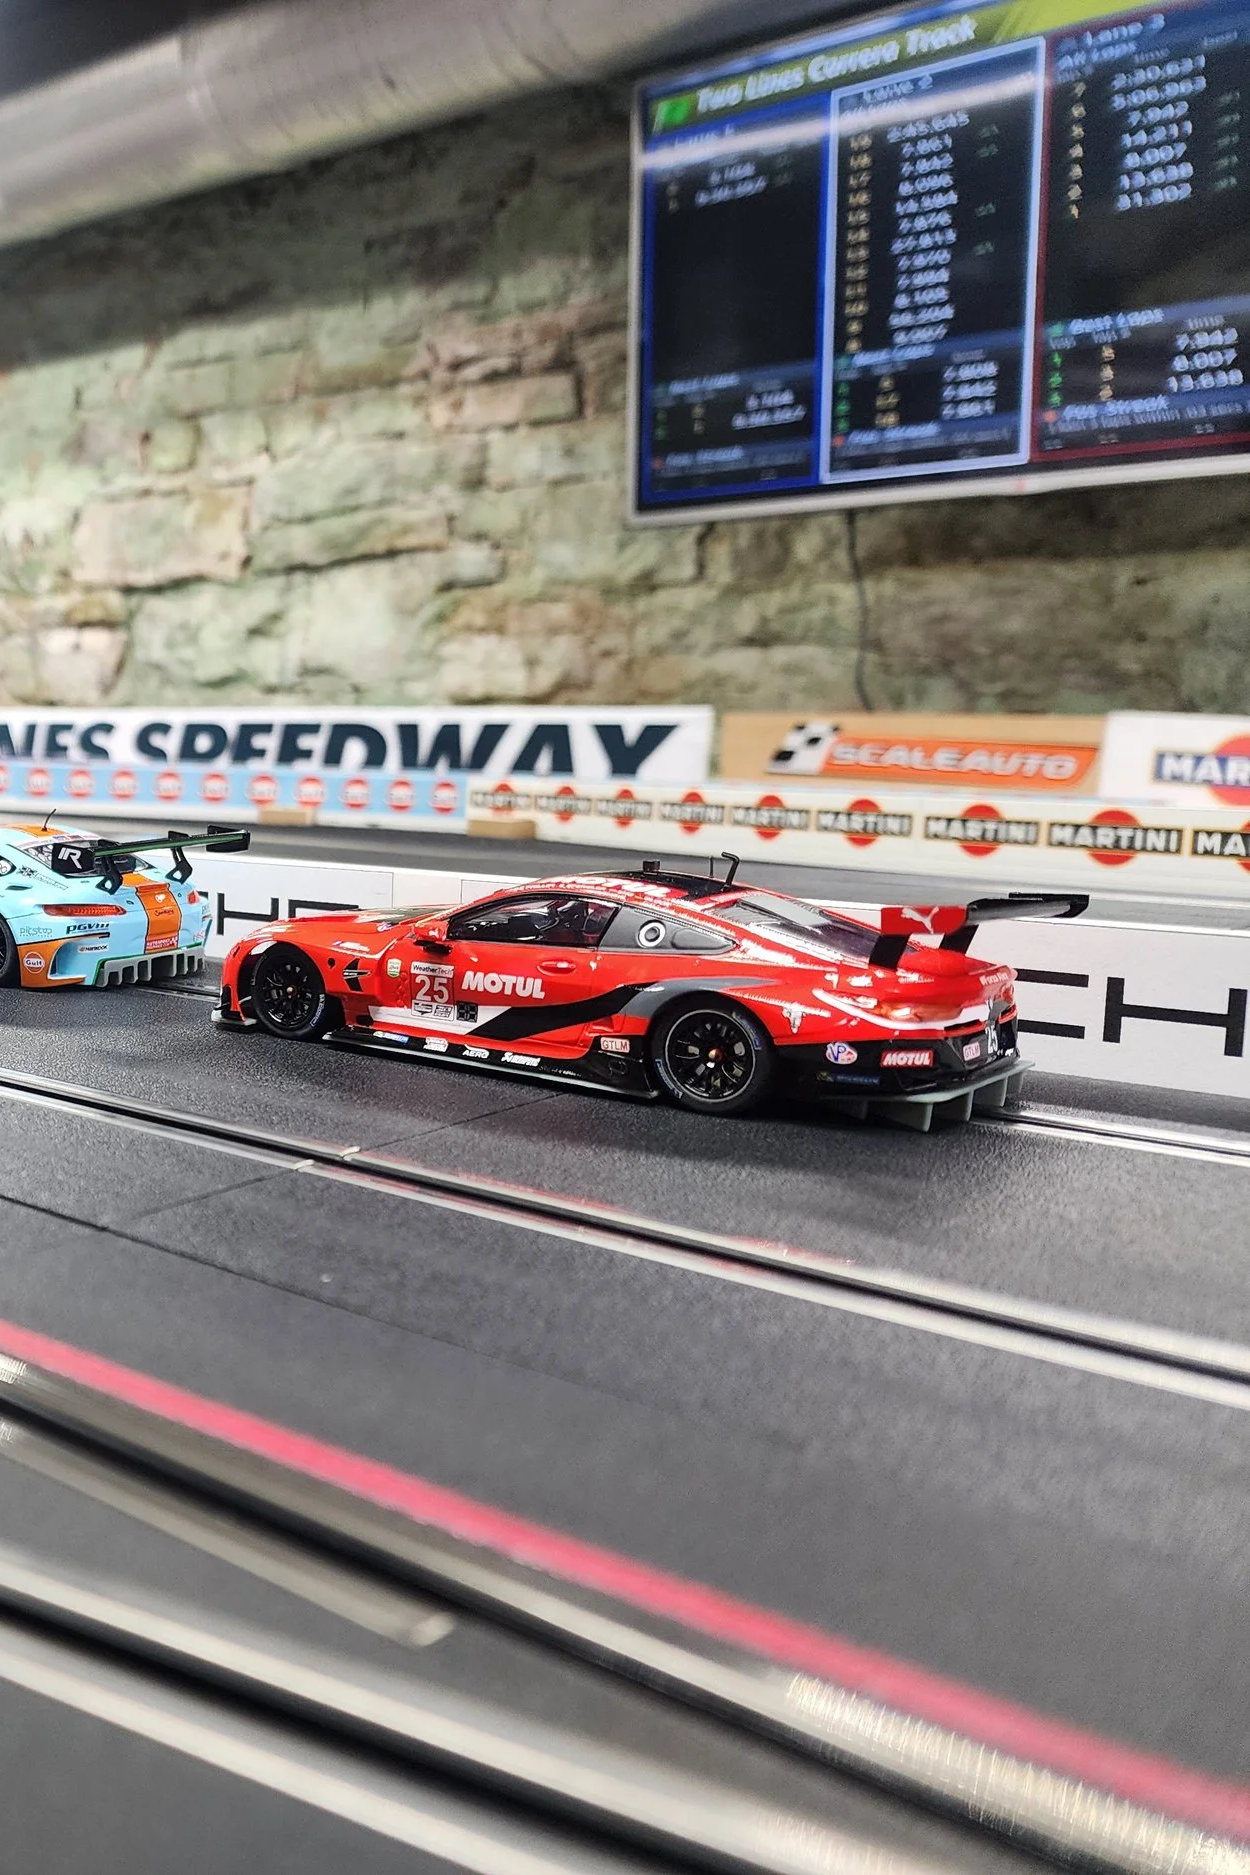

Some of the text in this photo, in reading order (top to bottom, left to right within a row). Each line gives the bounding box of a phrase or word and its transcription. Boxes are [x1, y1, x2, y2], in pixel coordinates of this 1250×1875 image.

[135, 722, 680, 777] SPEEDWAY
[829, 740, 1078, 781] SCALEAUTO
[732, 806, 810, 830] MARTINI
[818, 810, 911, 837] MARTINI
[925, 817, 1038, 845] MARTINI
[1050, 823, 1180, 853] MARTINI
[413, 963, 453, 976] WeatherTech
[415, 975, 449, 1003] 25
[461, 971, 545, 999] MOTUL
[602, 1039, 629, 1051] GTLM
[985, 1025, 998, 1055] 25
[463, 1050, 489, 1059] AERO
[882, 1053, 931, 1067] MOTUL
